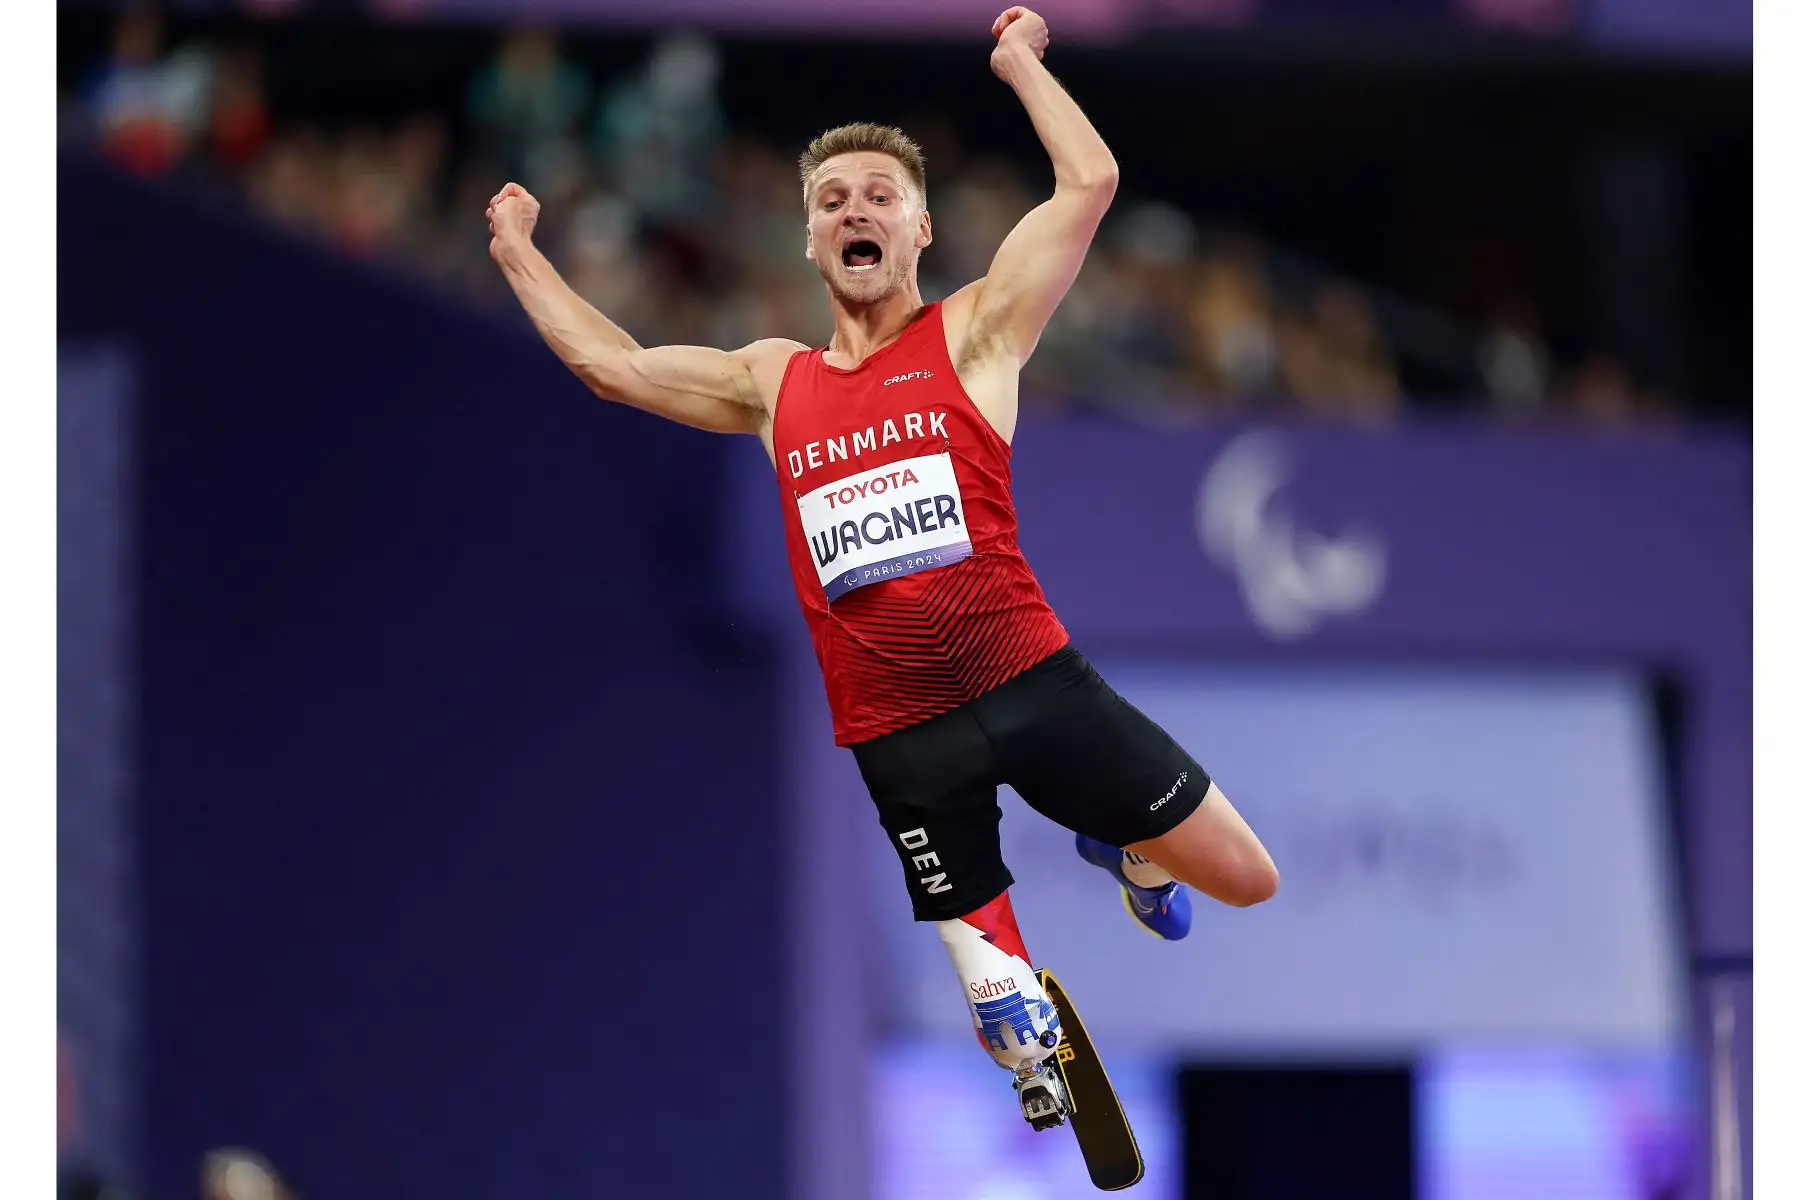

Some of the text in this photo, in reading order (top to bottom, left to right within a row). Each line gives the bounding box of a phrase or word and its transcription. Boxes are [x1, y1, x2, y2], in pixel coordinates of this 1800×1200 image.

[883, 371, 923, 386] CRAFT
[787, 411, 949, 479] DENMARK
[823, 468, 919, 509] TOYOTA
[811, 494, 960, 568] WAGNER
[864, 554, 942, 580] PARIS 2024
[1149, 777, 1182, 811] CRAFT
[899, 827, 953, 895] DEN
[970, 976, 1017, 1000] Sahva
